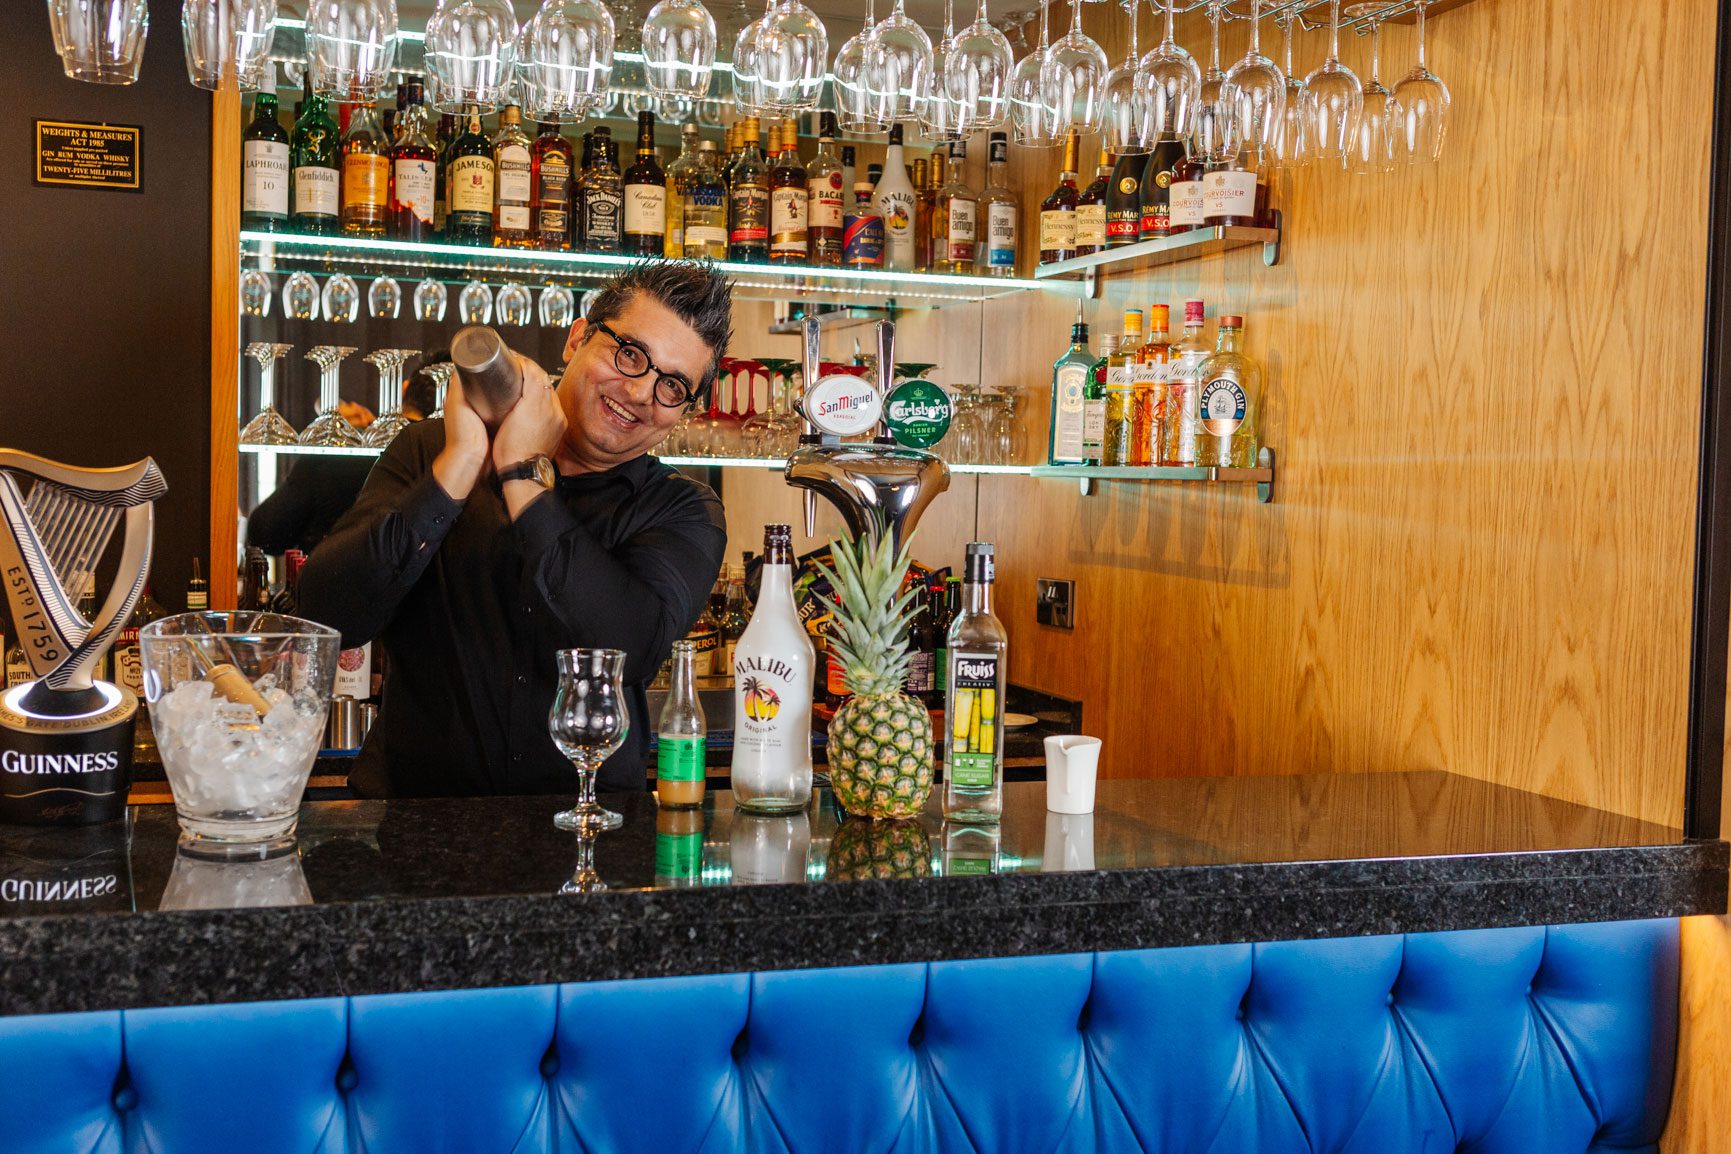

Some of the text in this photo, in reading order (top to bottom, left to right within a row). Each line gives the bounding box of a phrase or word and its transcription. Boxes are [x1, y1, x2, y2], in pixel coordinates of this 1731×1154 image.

[42, 127, 80, 138] WEIGHTS
[89, 131, 132, 141] MEASURES
[76, 152, 100, 160] VODKA
[103, 154, 130, 162] WHISKY
[43, 165, 88, 175] TWENTY-FIVE
[90, 167, 132, 177] MILLILITRES
[299, 170, 334, 182] Glenfiddich
[263, 181, 274, 190] 10
[693, 196, 723, 206] VODKA
[1110, 224, 1138, 233] V.S.O.
[1201, 380, 1245, 411] PLYMOUTH GIN
[889, 399, 949, 423] Carlsbrg
[23, 611, 59, 662] 1759
[693, 637, 717, 649] EROL
[9, 671, 33, 680] SOUTH
[736, 656, 797, 683] MALIBU
[63, 714, 108, 729] DUBLIN
[1, 750, 118, 774] GUINNESS
